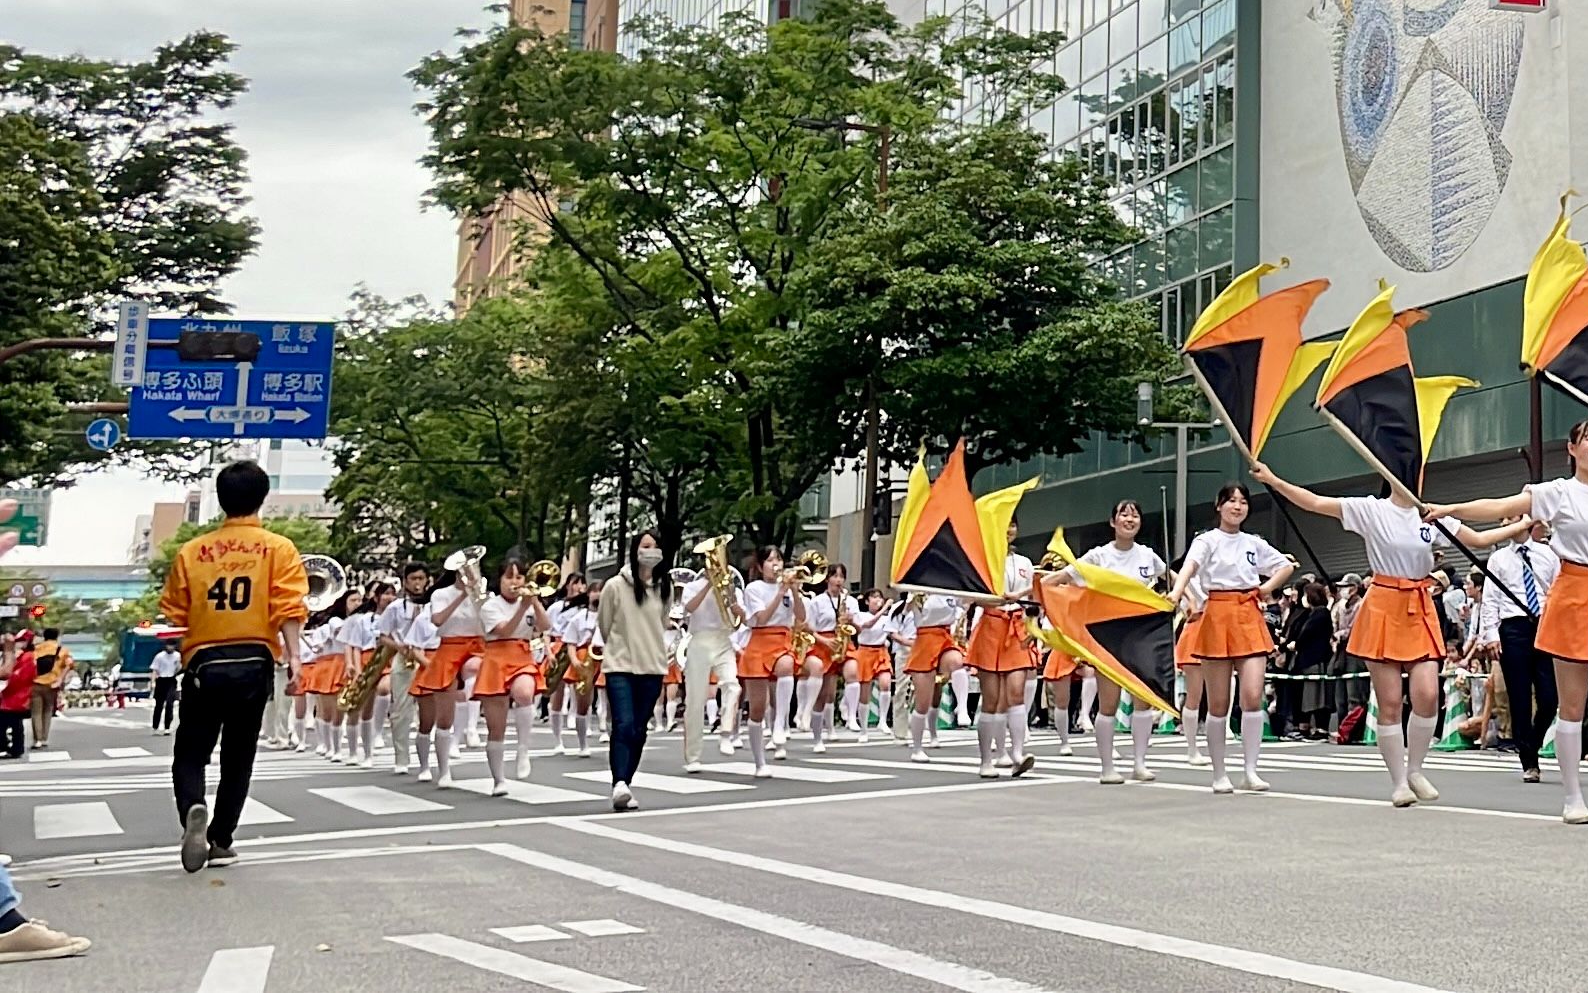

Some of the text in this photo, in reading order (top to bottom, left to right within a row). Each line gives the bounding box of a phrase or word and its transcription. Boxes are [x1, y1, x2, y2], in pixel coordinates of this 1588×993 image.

[263, 373, 323, 393] 博多駅
[142, 391, 220, 402] Hakata Wharf
[207, 575, 252, 611] 40
